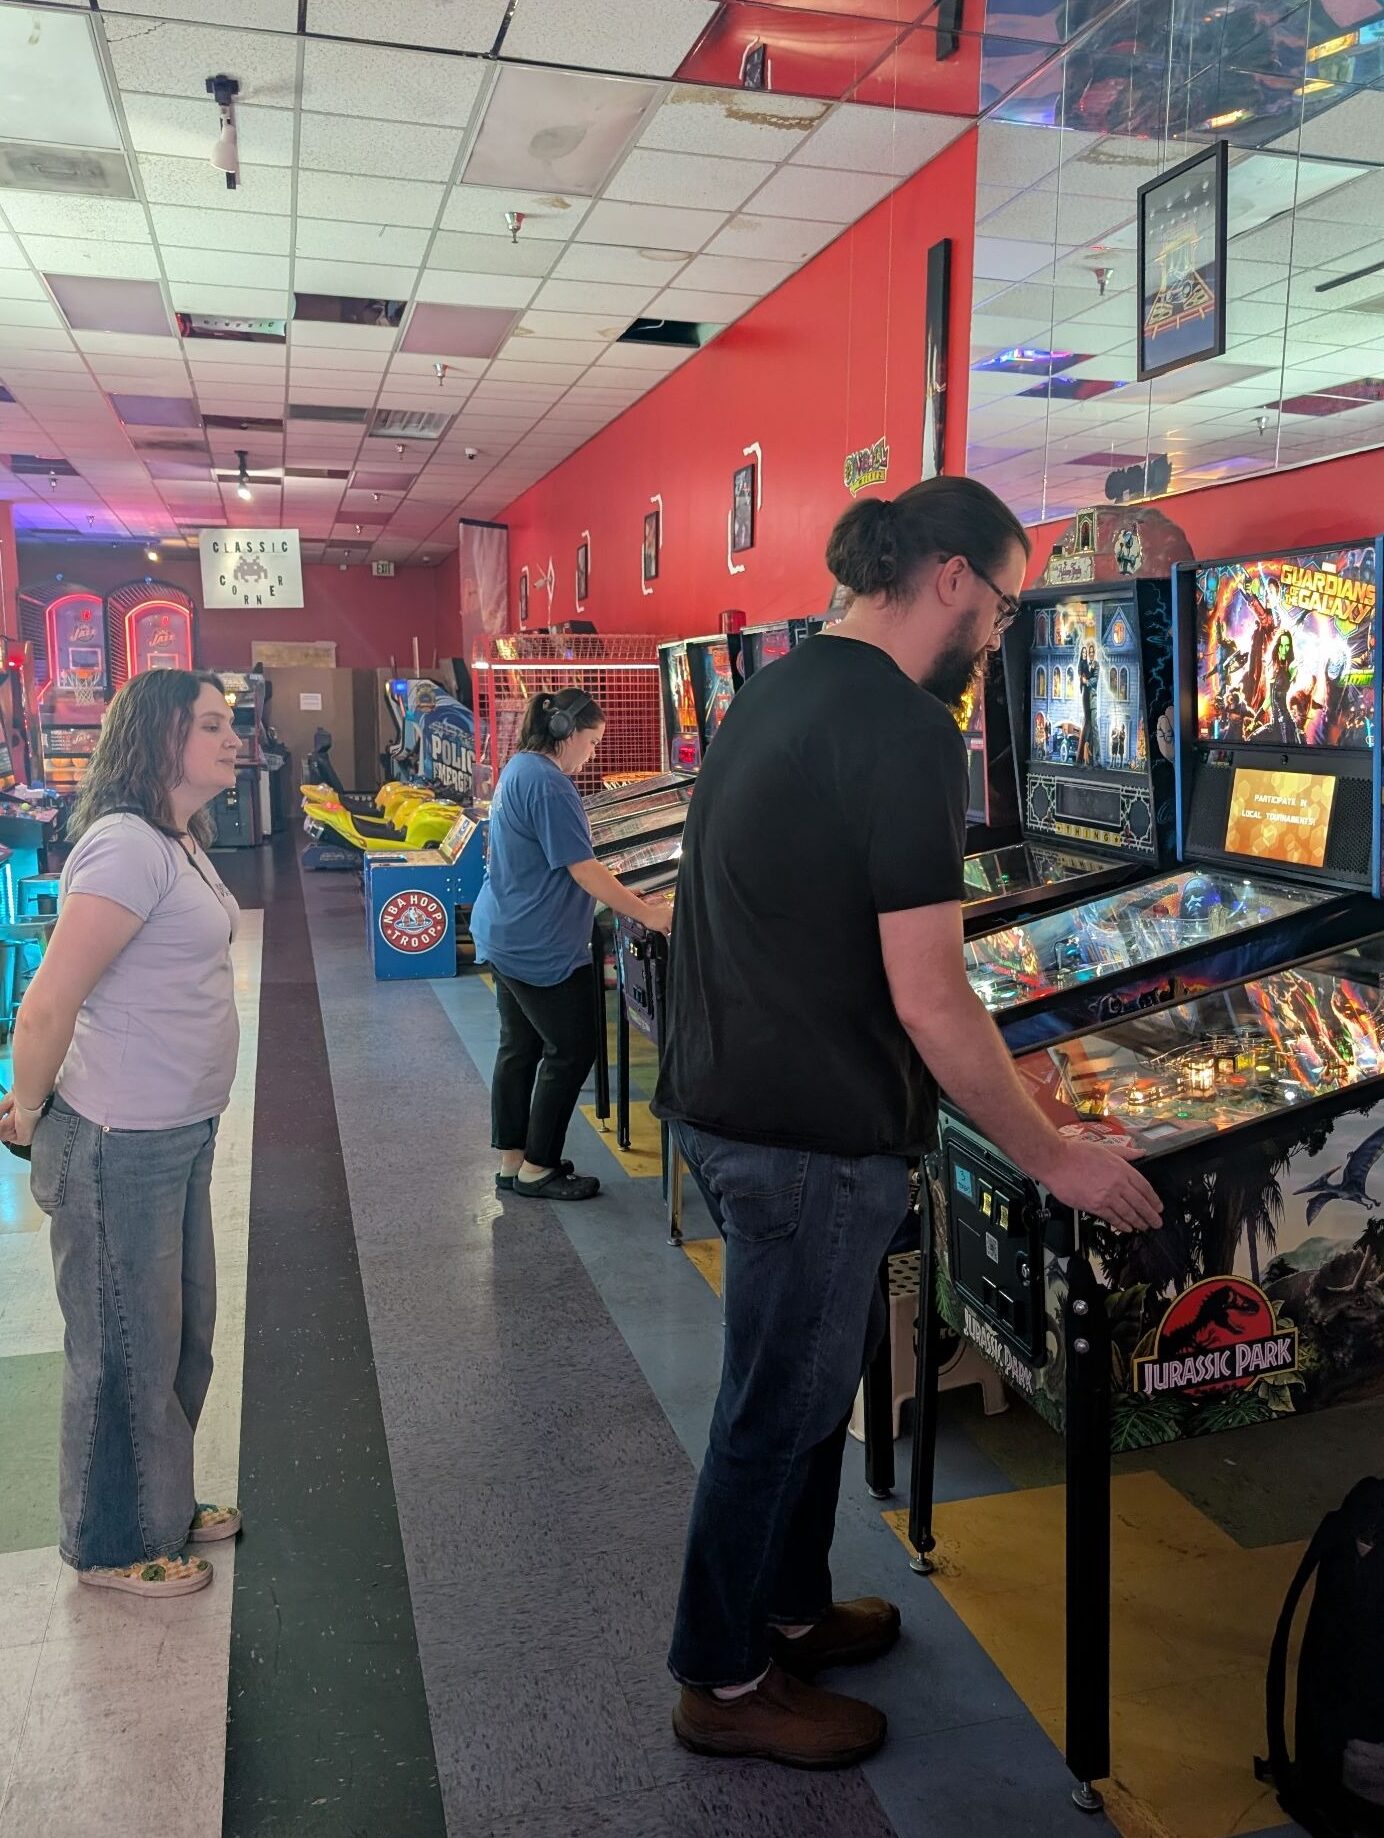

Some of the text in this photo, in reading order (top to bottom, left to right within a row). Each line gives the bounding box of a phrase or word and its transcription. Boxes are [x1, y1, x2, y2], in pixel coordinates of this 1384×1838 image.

[213, 541, 288, 553] CLASSIC
[219, 575, 283, 605] CORNER
[1280, 564, 1376, 606] GUARDIANS
[1298, 588, 1372, 624] GALAXY
[432, 733, 477, 774] POLIC
[1241, 810, 1262, 819] LOCAL
[1254, 794, 1297, 806] PARTICIPATE
[1066, 825, 1109, 842] THING
[384, 895, 443, 924] NBA HOOP
[391, 927, 437, 947] TROOP
[964, 1307, 1034, 1396] JURASSIC PARK
[1143, 1338, 1292, 1395] JURASSIC PARK
